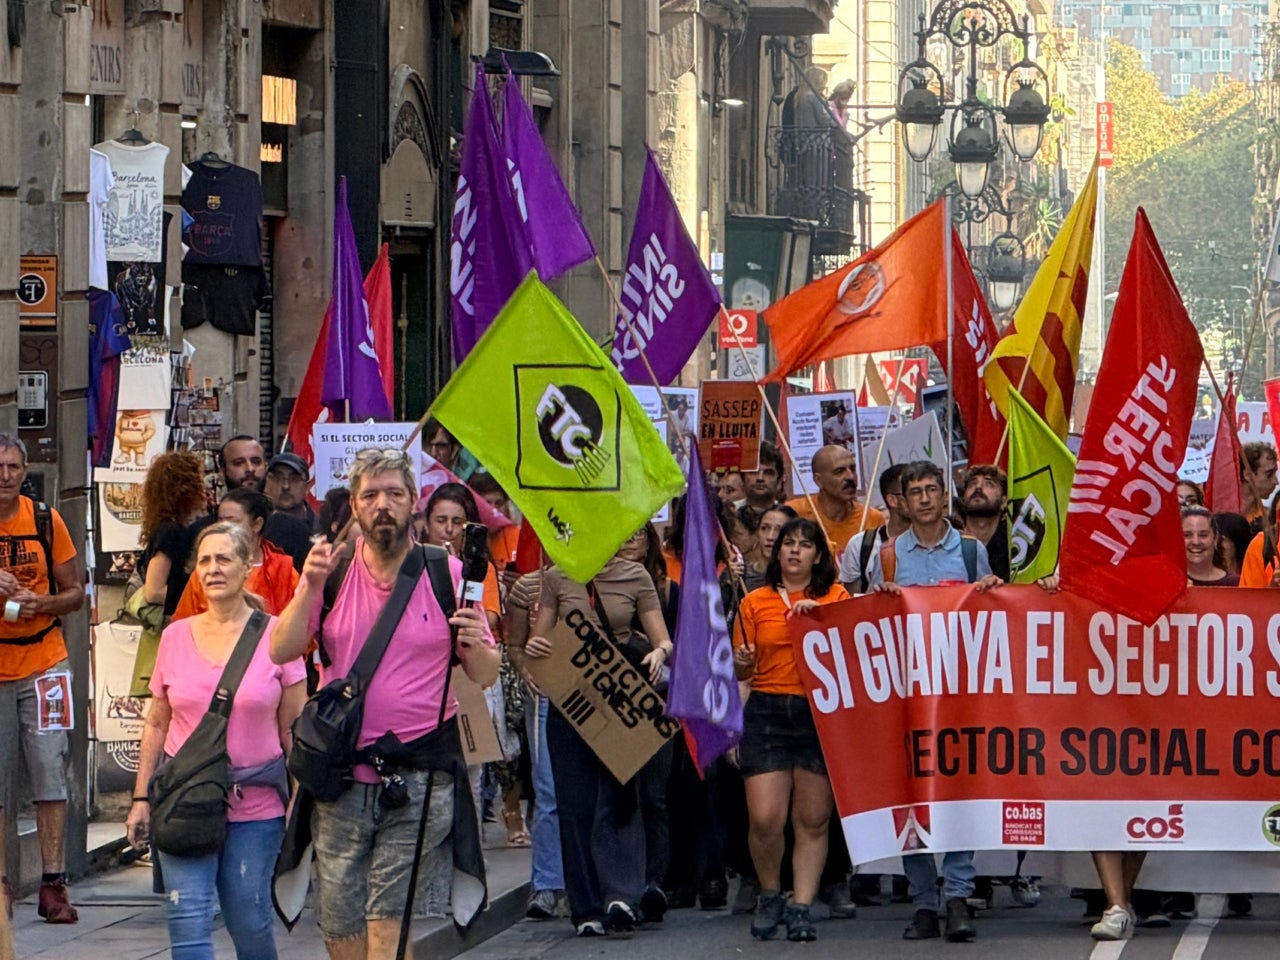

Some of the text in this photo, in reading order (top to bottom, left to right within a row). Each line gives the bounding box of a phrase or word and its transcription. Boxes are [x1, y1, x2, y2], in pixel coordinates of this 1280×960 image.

[702, 399, 759, 419] SASSEP
[535, 382, 593, 458] FTC
[321, 433, 408, 442] SI EL SECTOR SOCIAL
[702, 422, 757, 439] EN LLUITA
[802, 627, 855, 714] SI
[853, 610, 1014, 704] GUANYA
[1026, 610, 1078, 695] EL
[1087, 610, 1255, 698] SECTOR
[1060, 727, 1220, 777] SOCIAL
[1005, 803, 1043, 820] co.bas
